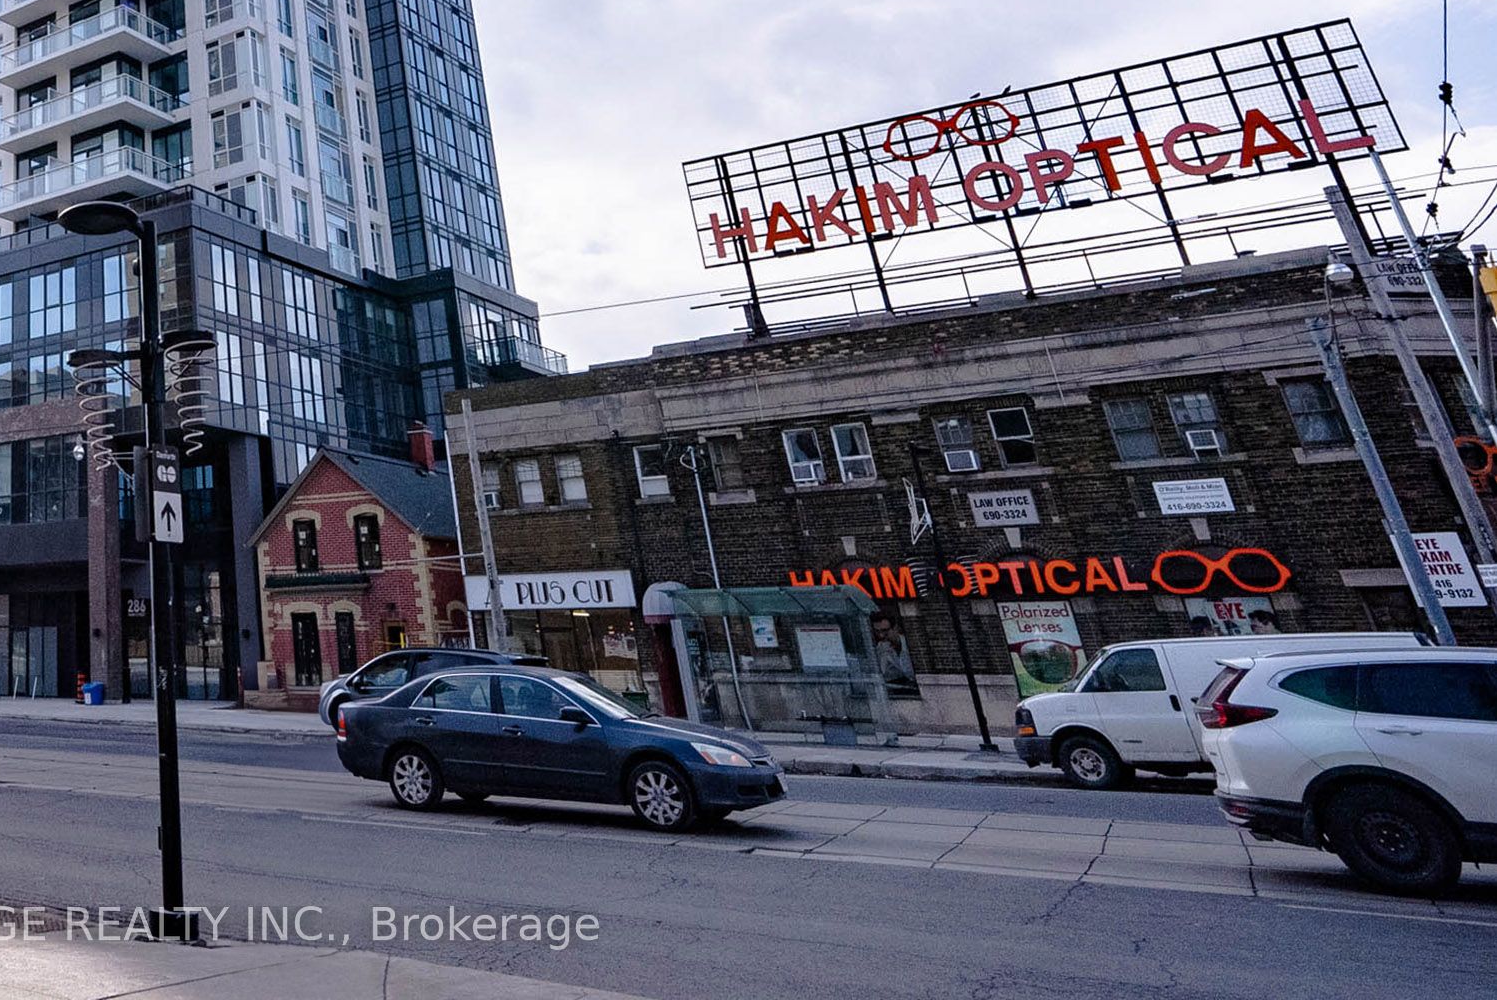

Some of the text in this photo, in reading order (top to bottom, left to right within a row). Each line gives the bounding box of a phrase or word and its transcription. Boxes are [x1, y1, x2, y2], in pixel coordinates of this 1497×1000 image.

[709, 99, 1377, 259] HAKIM OPTICAL
[973, 496, 1030, 508] LAW OFFICE
[1167, 501, 1227, 511] 416-690-3324
[983, 509, 1028, 520] 690-3324
[1414, 538, 1440, 550] EYE
[1420, 551, 1453, 563] XAM
[1425, 564, 1464, 576] ENTRE
[789, 556, 1148, 599] HAKIM OPTICAL
[515, 580, 566, 605] PLUS
[573, 579, 614, 603] CUT
[127, 599, 146, 613] 286
[1002, 602, 1070, 620] Polarized
[1214, 602, 1246, 621] EYE
[1016, 620, 1064, 633] Lenses
